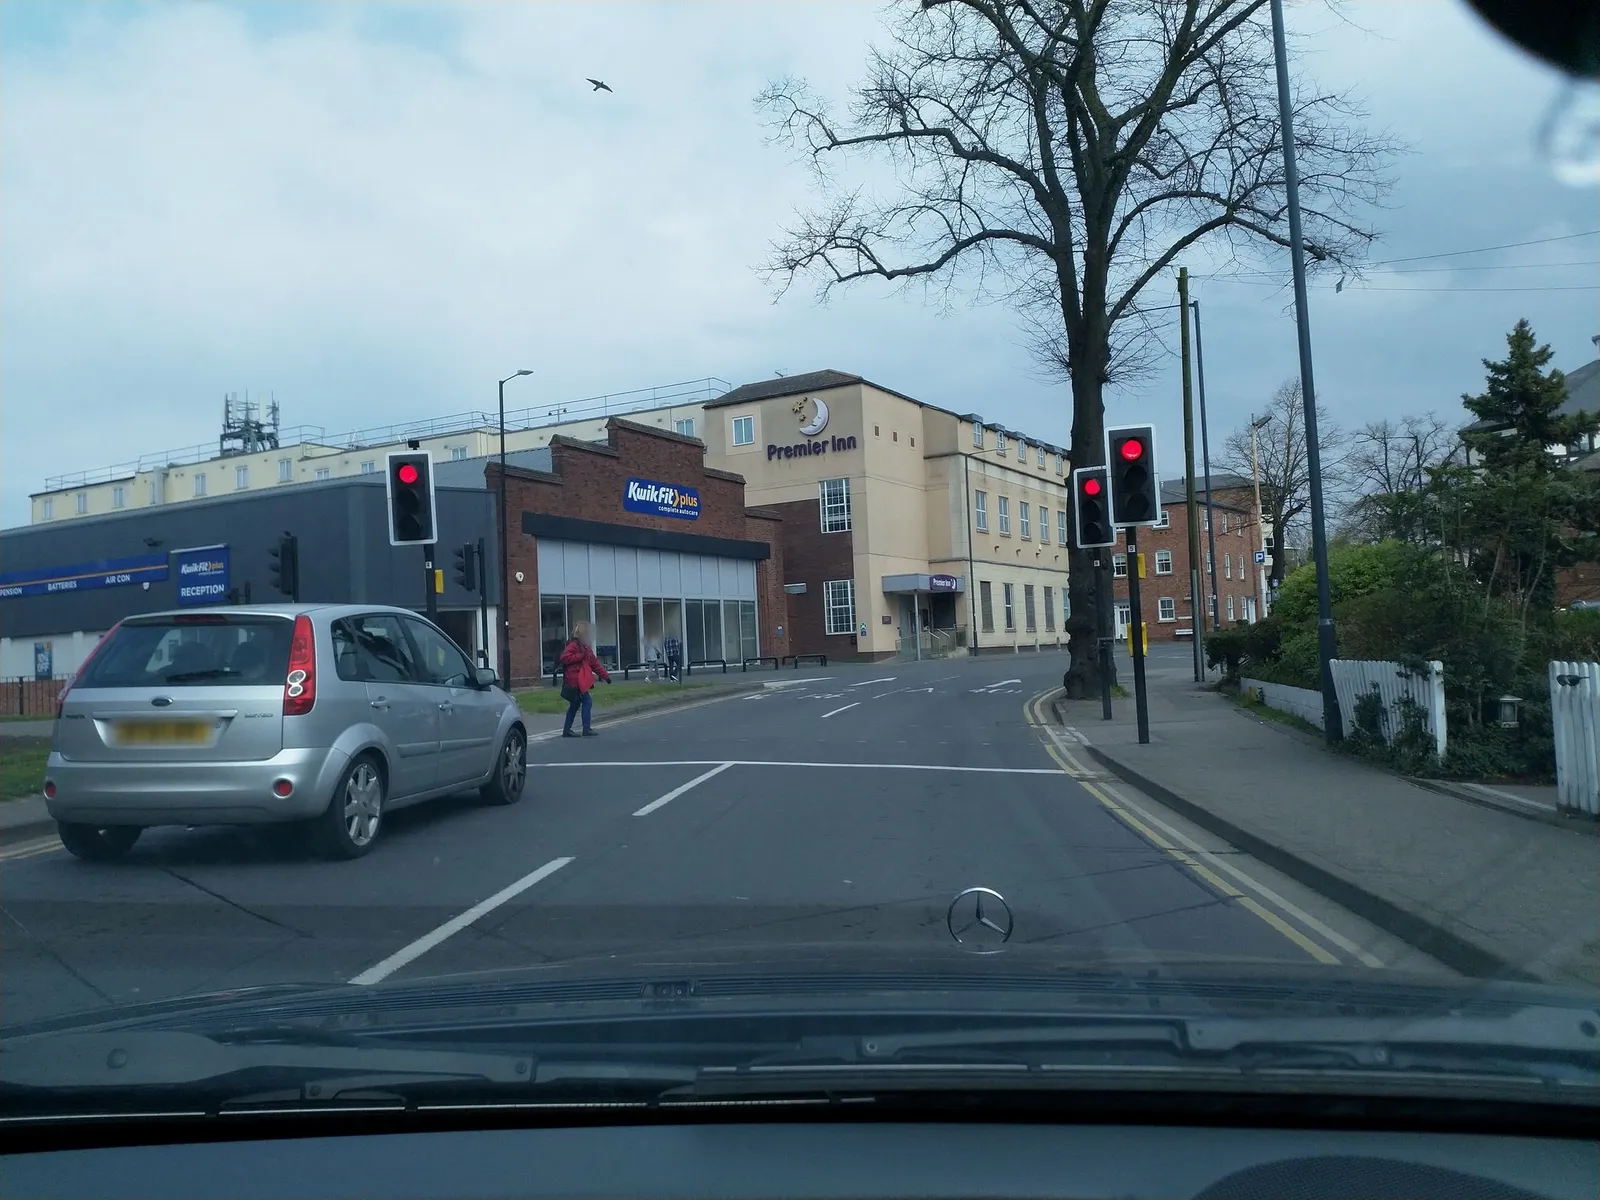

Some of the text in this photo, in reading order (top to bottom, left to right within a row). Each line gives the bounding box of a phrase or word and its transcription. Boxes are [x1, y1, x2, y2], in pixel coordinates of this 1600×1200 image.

[767, 435, 857, 460] Premier Inn
[680, 493, 698, 508] plus
[658, 505, 698, 517] complete autocare
[1255, 552, 1264, 563] P
[105, 574, 131, 584] AIR CON
[47, 581, 77, 591] BATTERIES
[181, 584, 225, 597] RECEPTION
